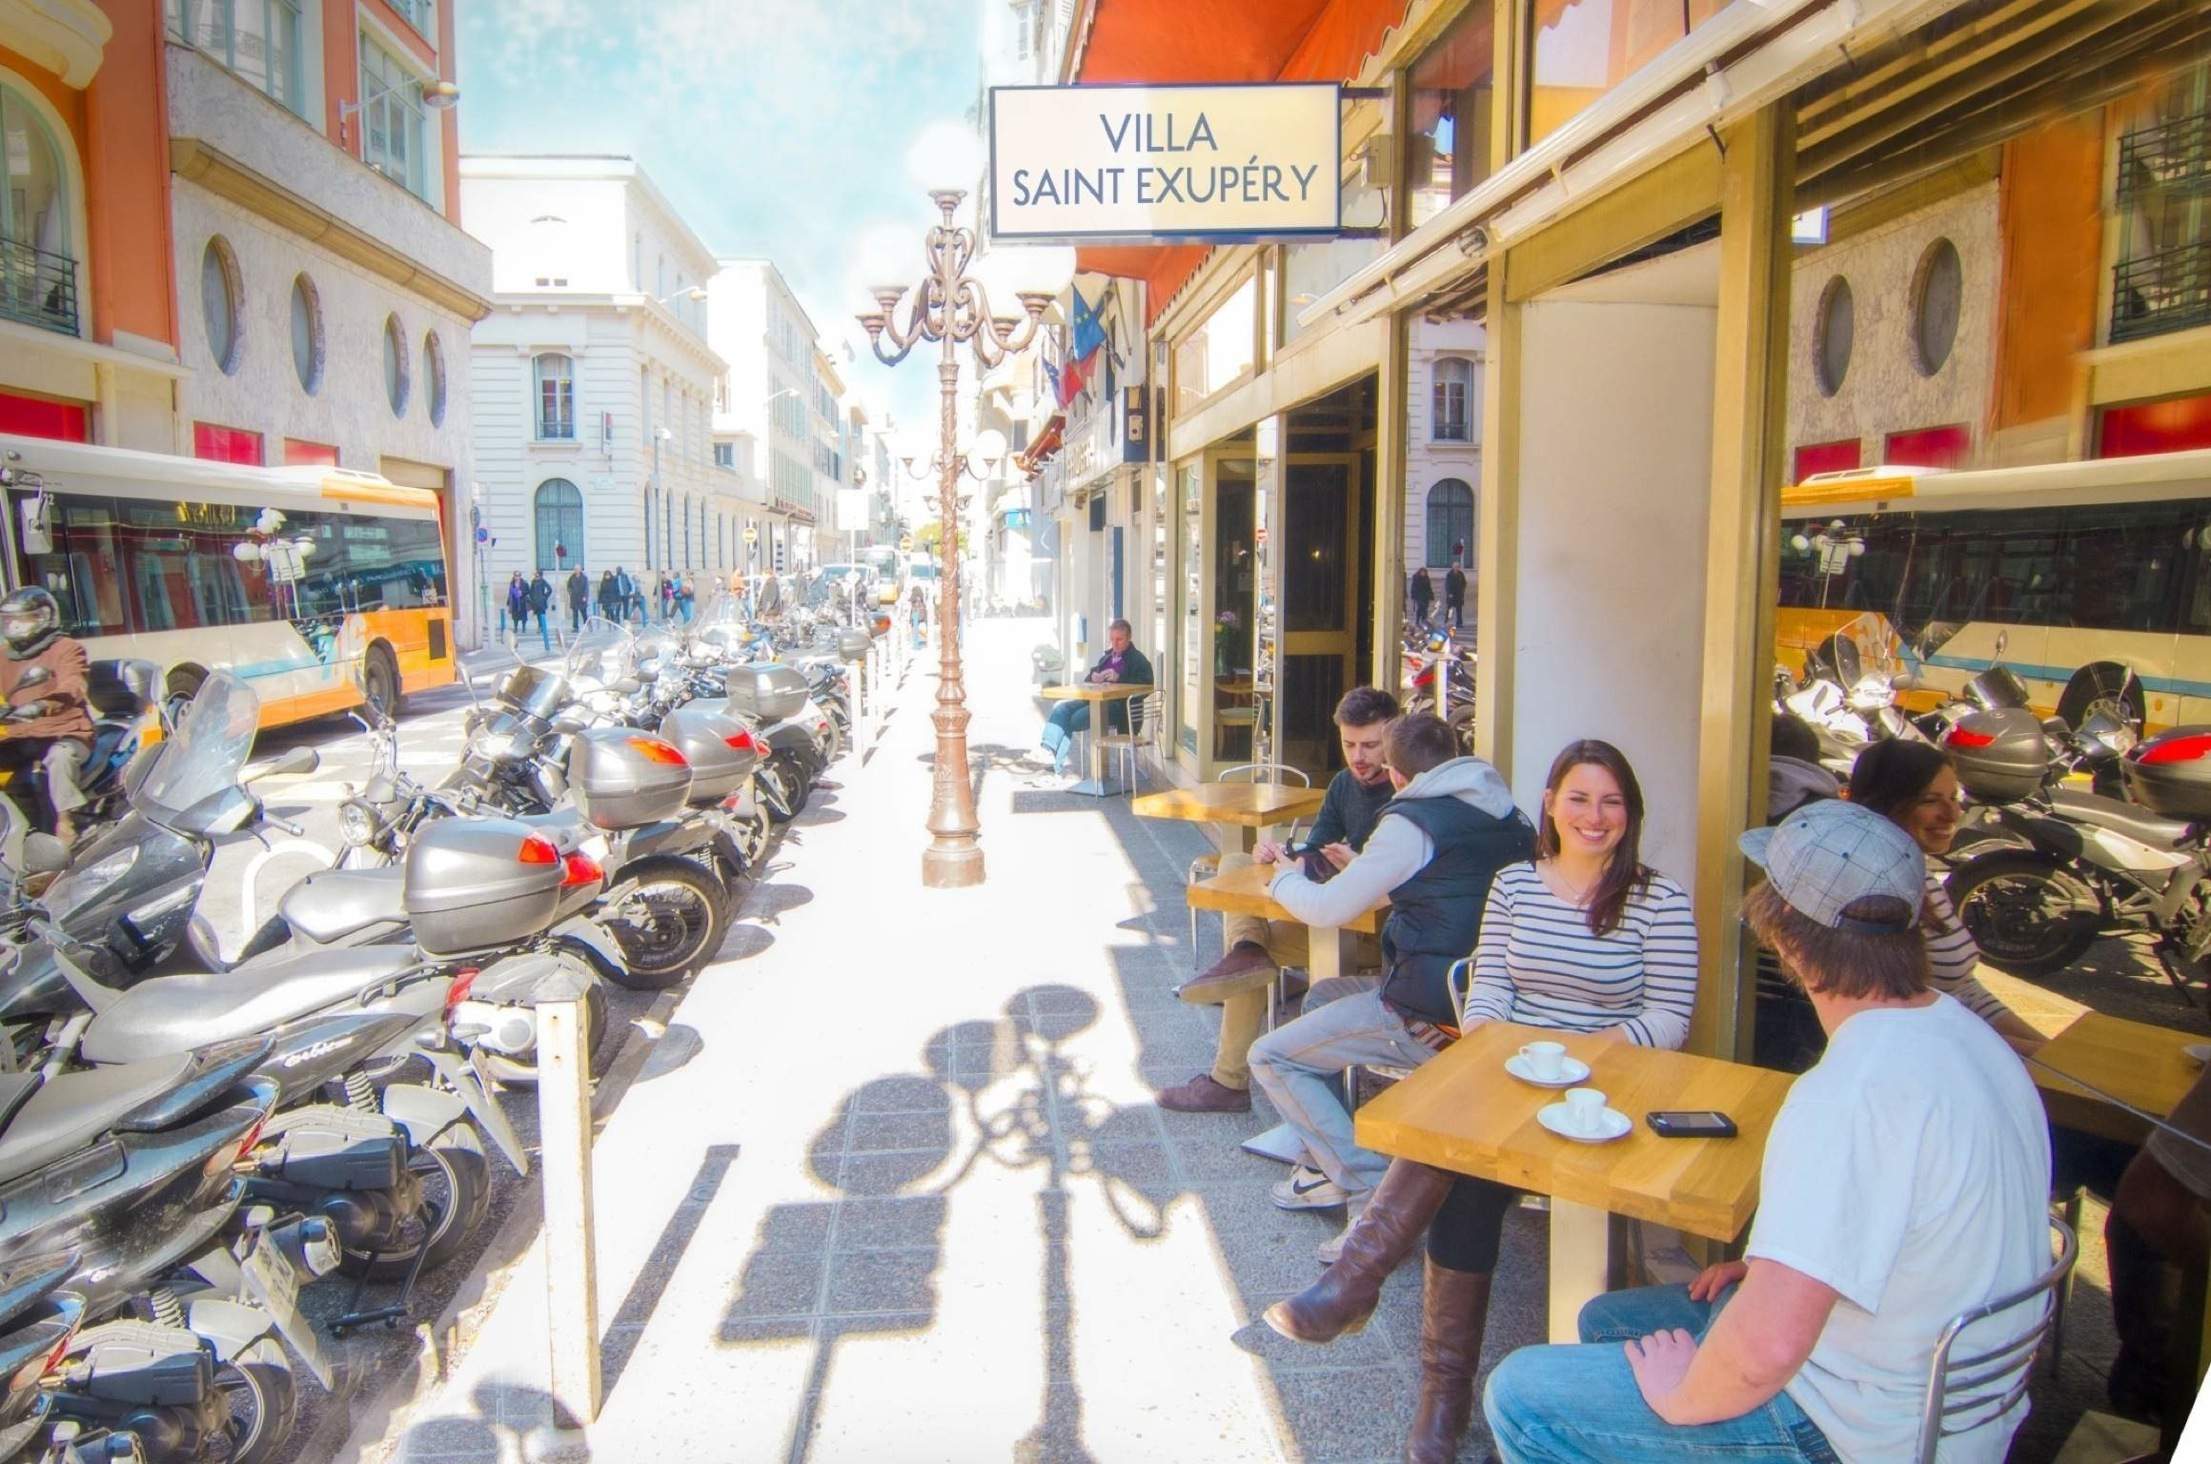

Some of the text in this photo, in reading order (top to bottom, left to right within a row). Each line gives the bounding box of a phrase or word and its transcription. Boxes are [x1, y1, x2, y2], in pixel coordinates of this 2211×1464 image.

[1099, 112, 1218, 153] VILLA
[1013, 155, 1318, 206] SAINT EXUPÉRY
